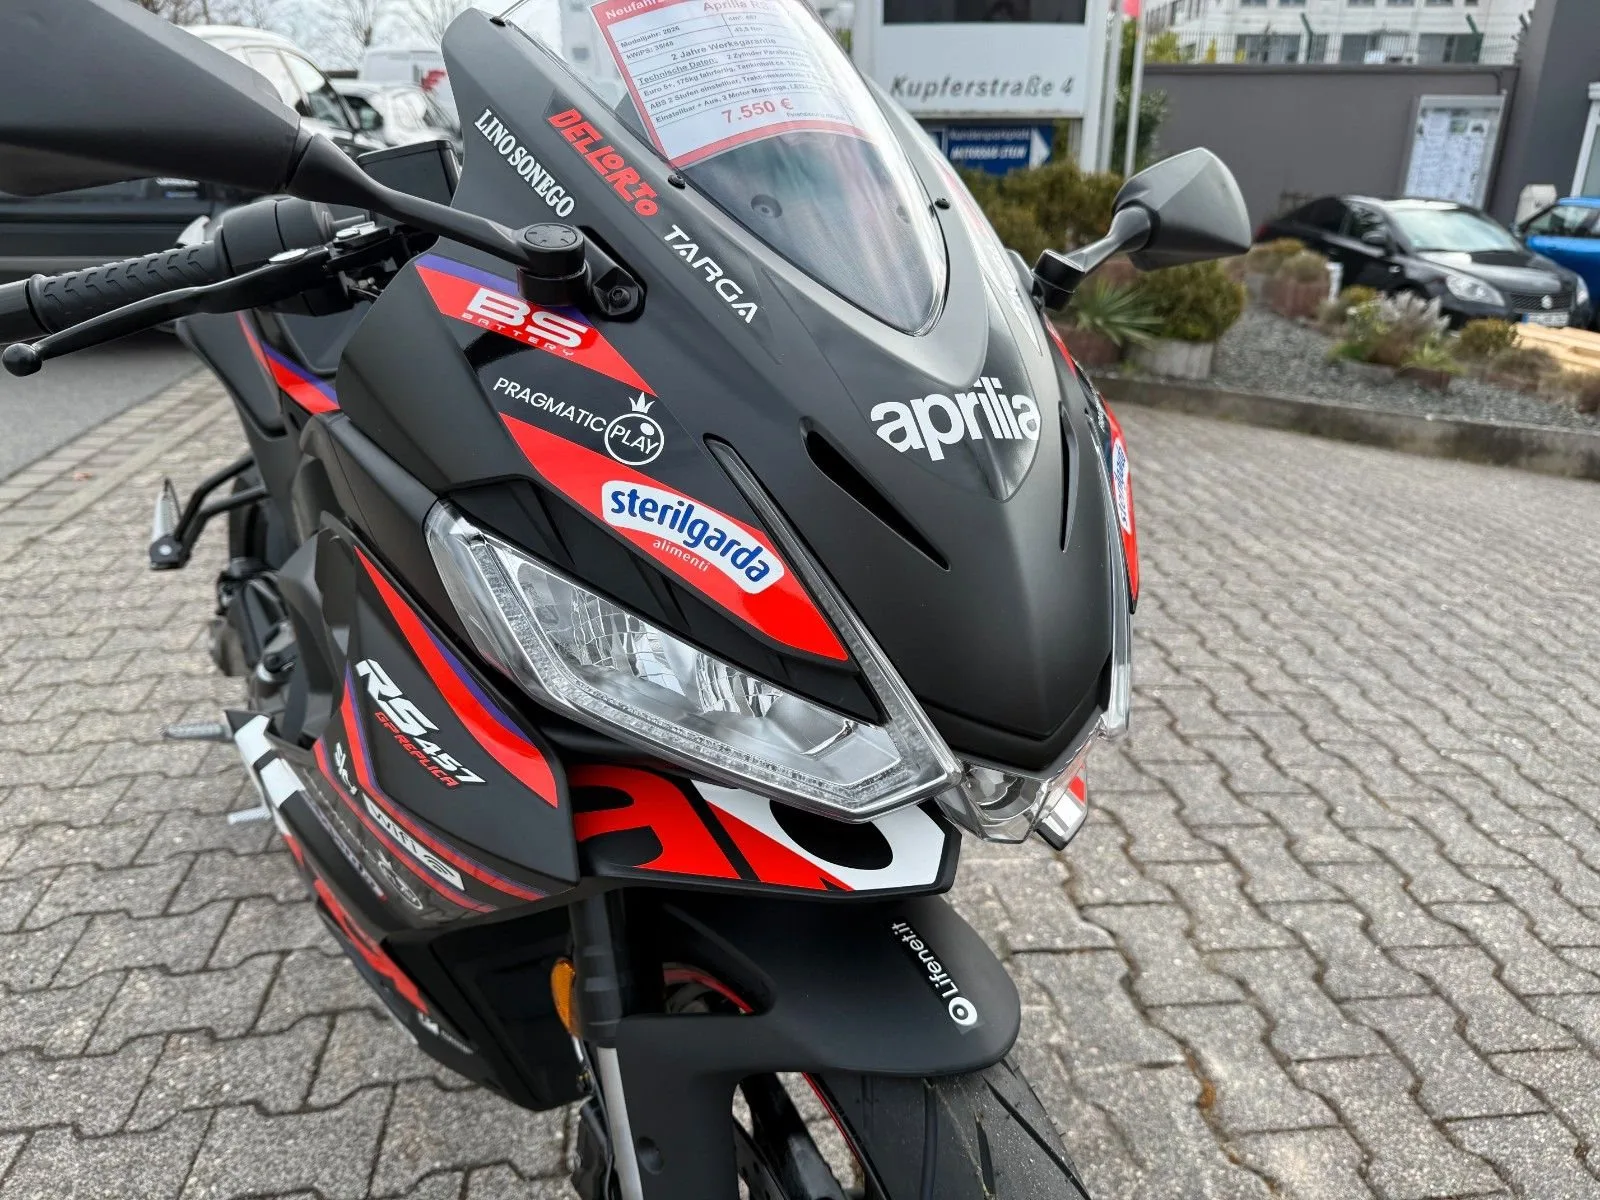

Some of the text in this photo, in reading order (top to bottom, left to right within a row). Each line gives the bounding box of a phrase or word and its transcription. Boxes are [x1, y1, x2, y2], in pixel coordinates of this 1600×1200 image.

[605, 0, 664, 19] Neufahr
[680, 47, 707, 59] Jahre
[708, 38, 776, 52] Werksgarantie
[638, 65, 688, 85] Technische
[643, 87, 662, 97] Euro
[677, 75, 698, 86] 175kg
[889, 73, 1075, 102] Kupferstraße 4
[650, 99, 667, 110] ABS
[675, 89, 699, 101] Stufen
[656, 104, 696, 123] Einstellbar
[728, 90, 750, 100] Motor
[721, 98, 794, 123] 7.550 €
[474, 108, 575, 218] LINO SONEGO
[663, 224, 759, 324] TARGA
[461, 312, 574, 356] BATTERY
[467, 287, 589, 348] BS
[493, 377, 659, 455] PRAGMATIC PLAY
[870, 376, 1041, 462] aprilia
[610, 488, 770, 583] sterilgarda
[653, 537, 711, 573] alimenti
[355, 659, 487, 783] RS 457
[394, 734, 460, 787] REPLICA
[891, 922, 959, 998] Lifenet.it
